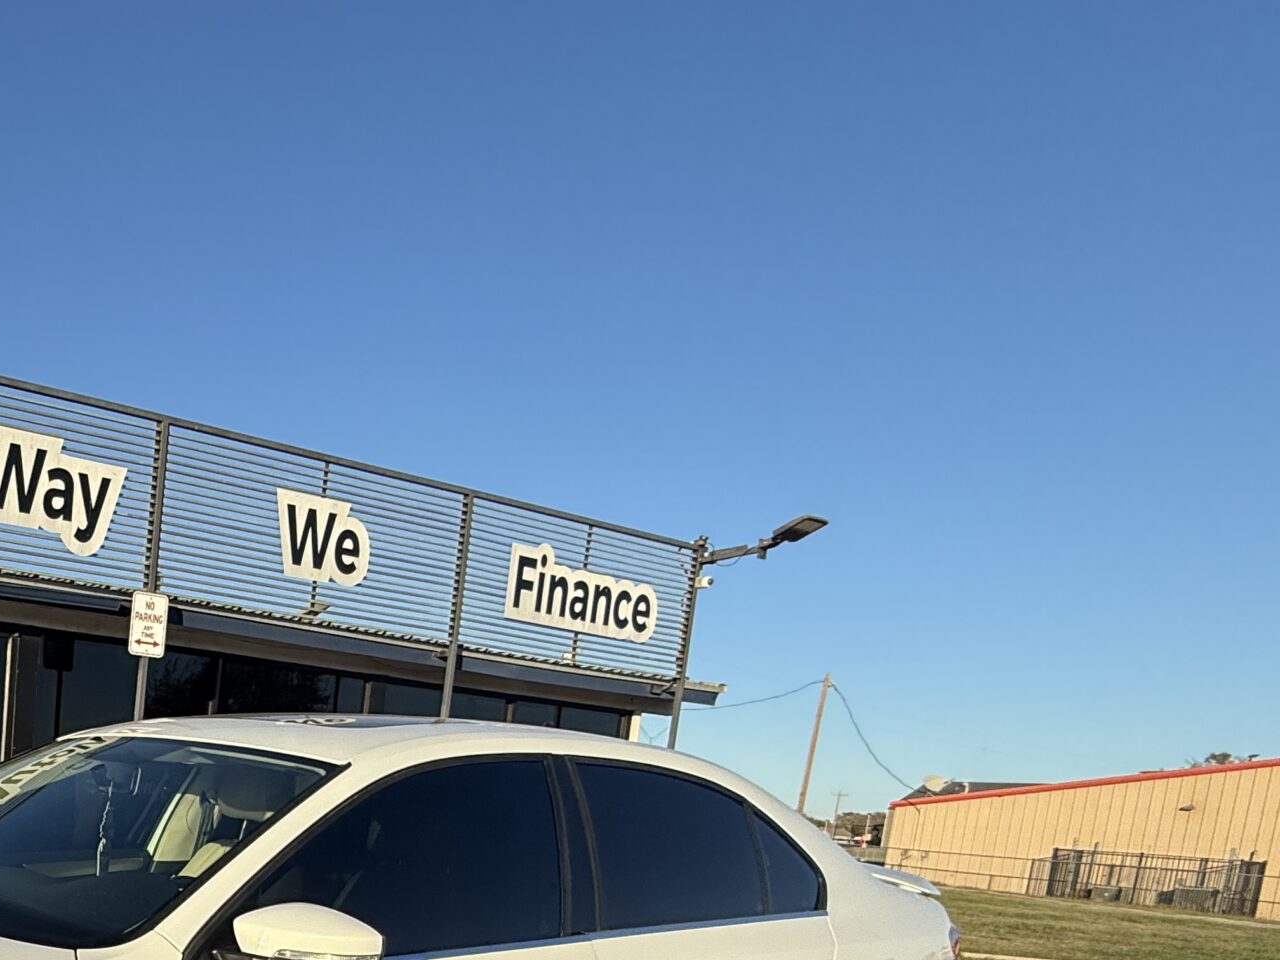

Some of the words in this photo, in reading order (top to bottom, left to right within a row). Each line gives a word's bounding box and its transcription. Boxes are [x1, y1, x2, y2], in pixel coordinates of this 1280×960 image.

[287, 504, 360, 575] We
[145, 601, 155, 611] NO
[513, 554, 652, 633] Finance
[135, 611, 163, 624] PARKING
